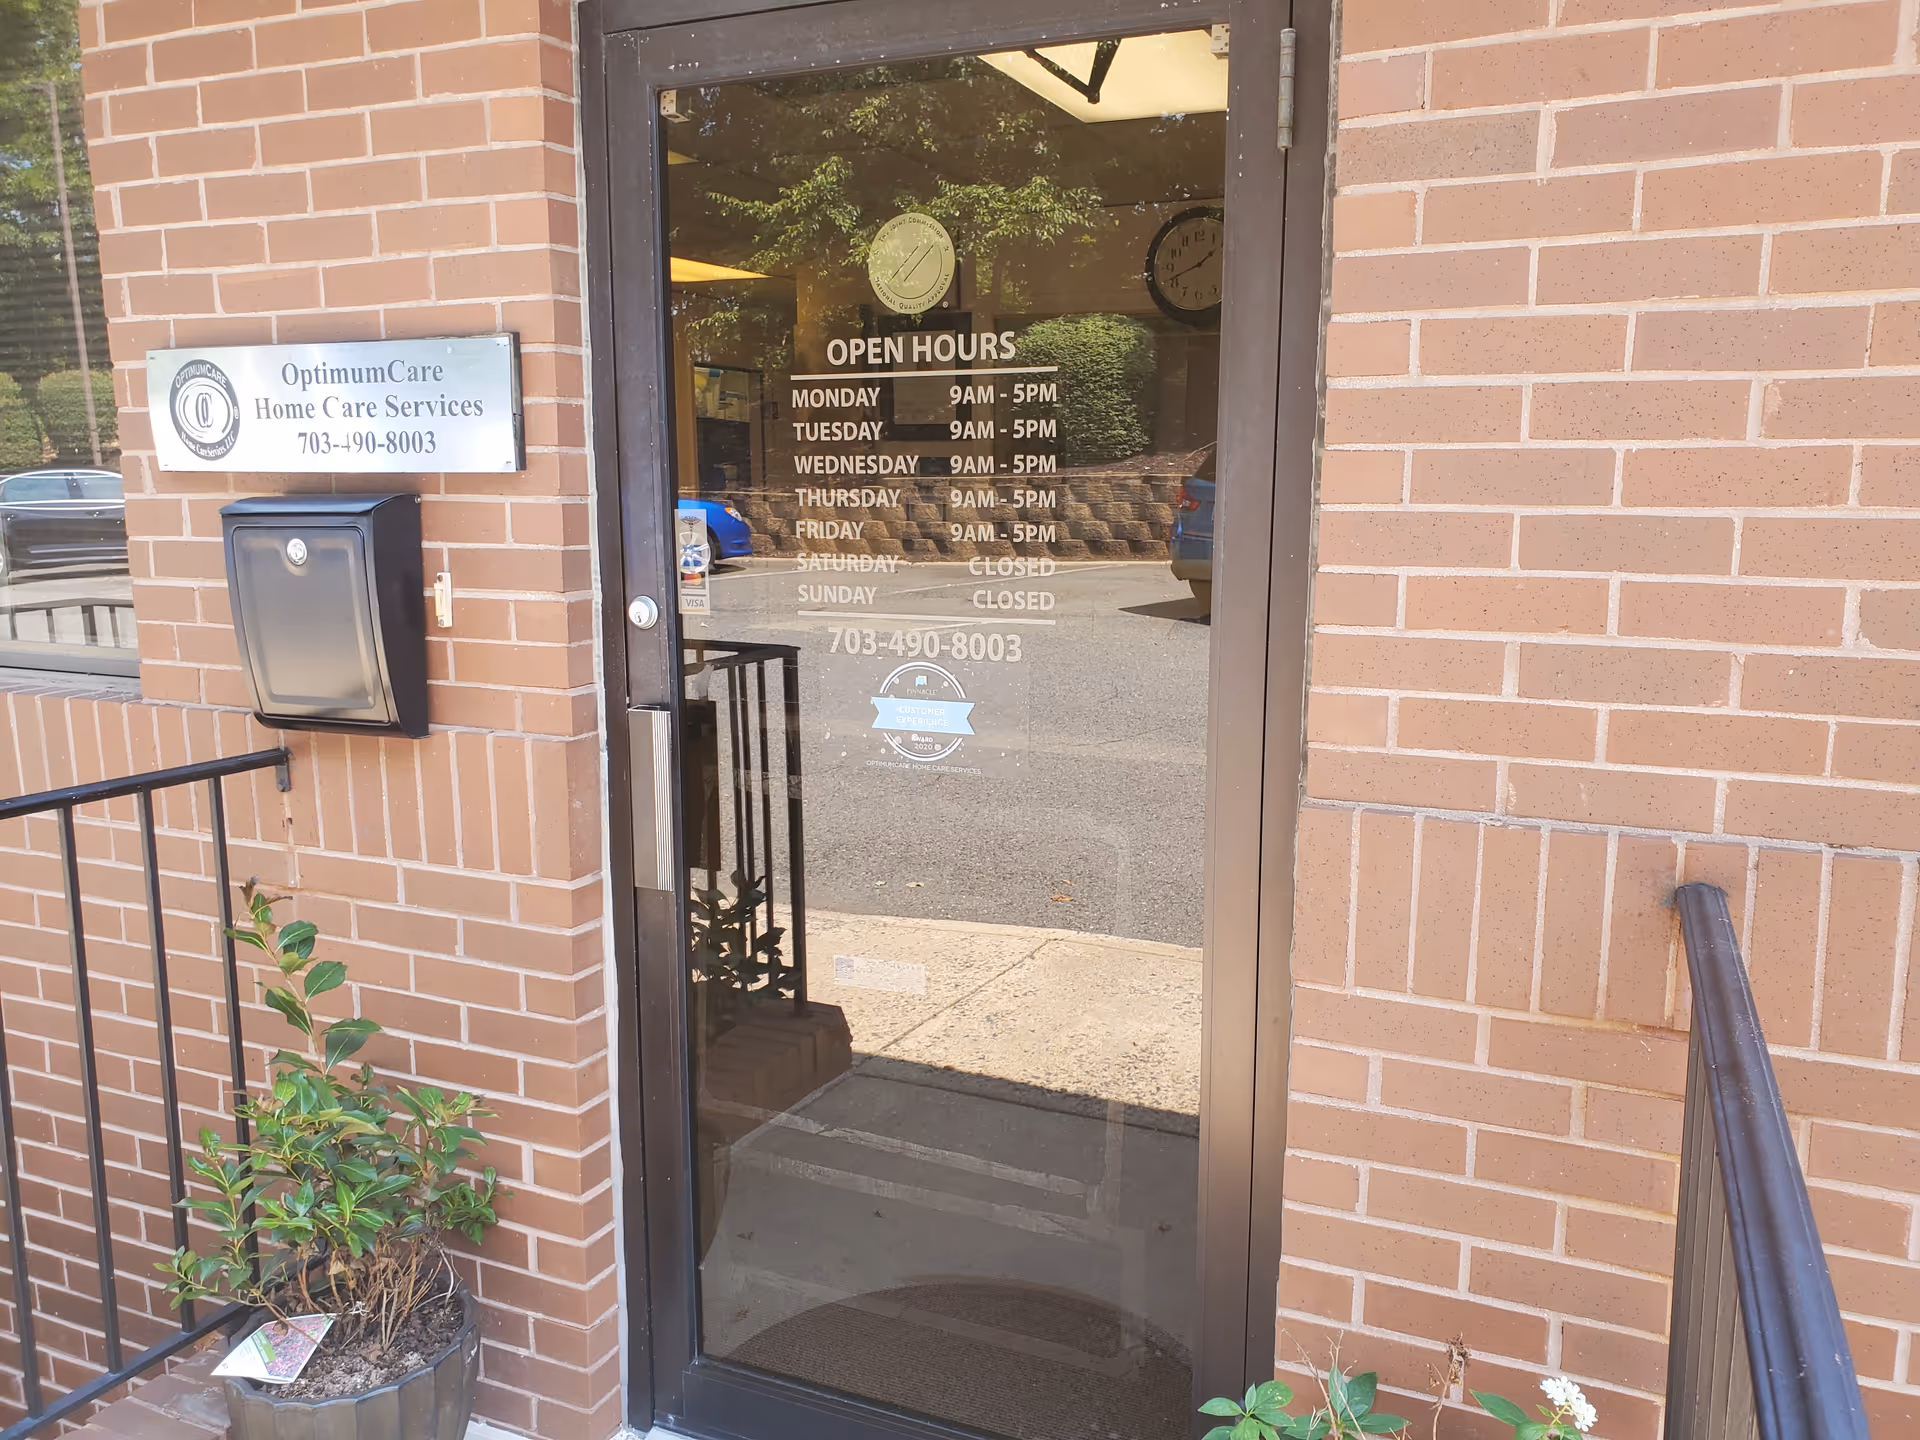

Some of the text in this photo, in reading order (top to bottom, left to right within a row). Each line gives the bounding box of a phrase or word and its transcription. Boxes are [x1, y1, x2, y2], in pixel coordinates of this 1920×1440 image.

[826, 331, 1016, 366] OPEN HOURS
[175, 364, 227, 388] OPTIMUMCARE
[281, 359, 444, 391] OptimumCare
[255, 394, 484, 420] Home Care Services
[791, 387, 881, 409] MONDAY
[949, 385, 994, 405] 9AM
[1012, 383, 1058, 403] 5PM
[298, 430, 437, 454] 703-490-8003
[793, 421, 883, 441] TUESDAY
[949, 421, 994, 440] 9AM
[1012, 419, 1057, 439] 5PM
[794, 455, 919, 475] WEDNESDAY
[950, 455, 995, 474] 9AM
[1012, 454, 1057, 474] 5PM
[795, 488, 901, 508] THURSDAY
[950, 489, 995, 508] 9AM
[1012, 489, 1056, 508] 5PM
[795, 521, 864, 540] FRIDAY
[950, 523, 995, 542] 9AM
[1012, 523, 1056, 543] 5PM
[797, 552, 1056, 577] SATURDAY CLOSED
[686, 599, 704, 607] VISA
[798, 584, 1055, 610] SUNDAY CLOSED
[828, 627, 1022, 662] 703-490-8003
[896, 716, 949, 727] EXPERIENCE
[898, 705, 945, 716] CUSTOMER
[866, 760, 911, 769] OPTIMUMCARE
[951, 766, 981, 775] SERVICES
